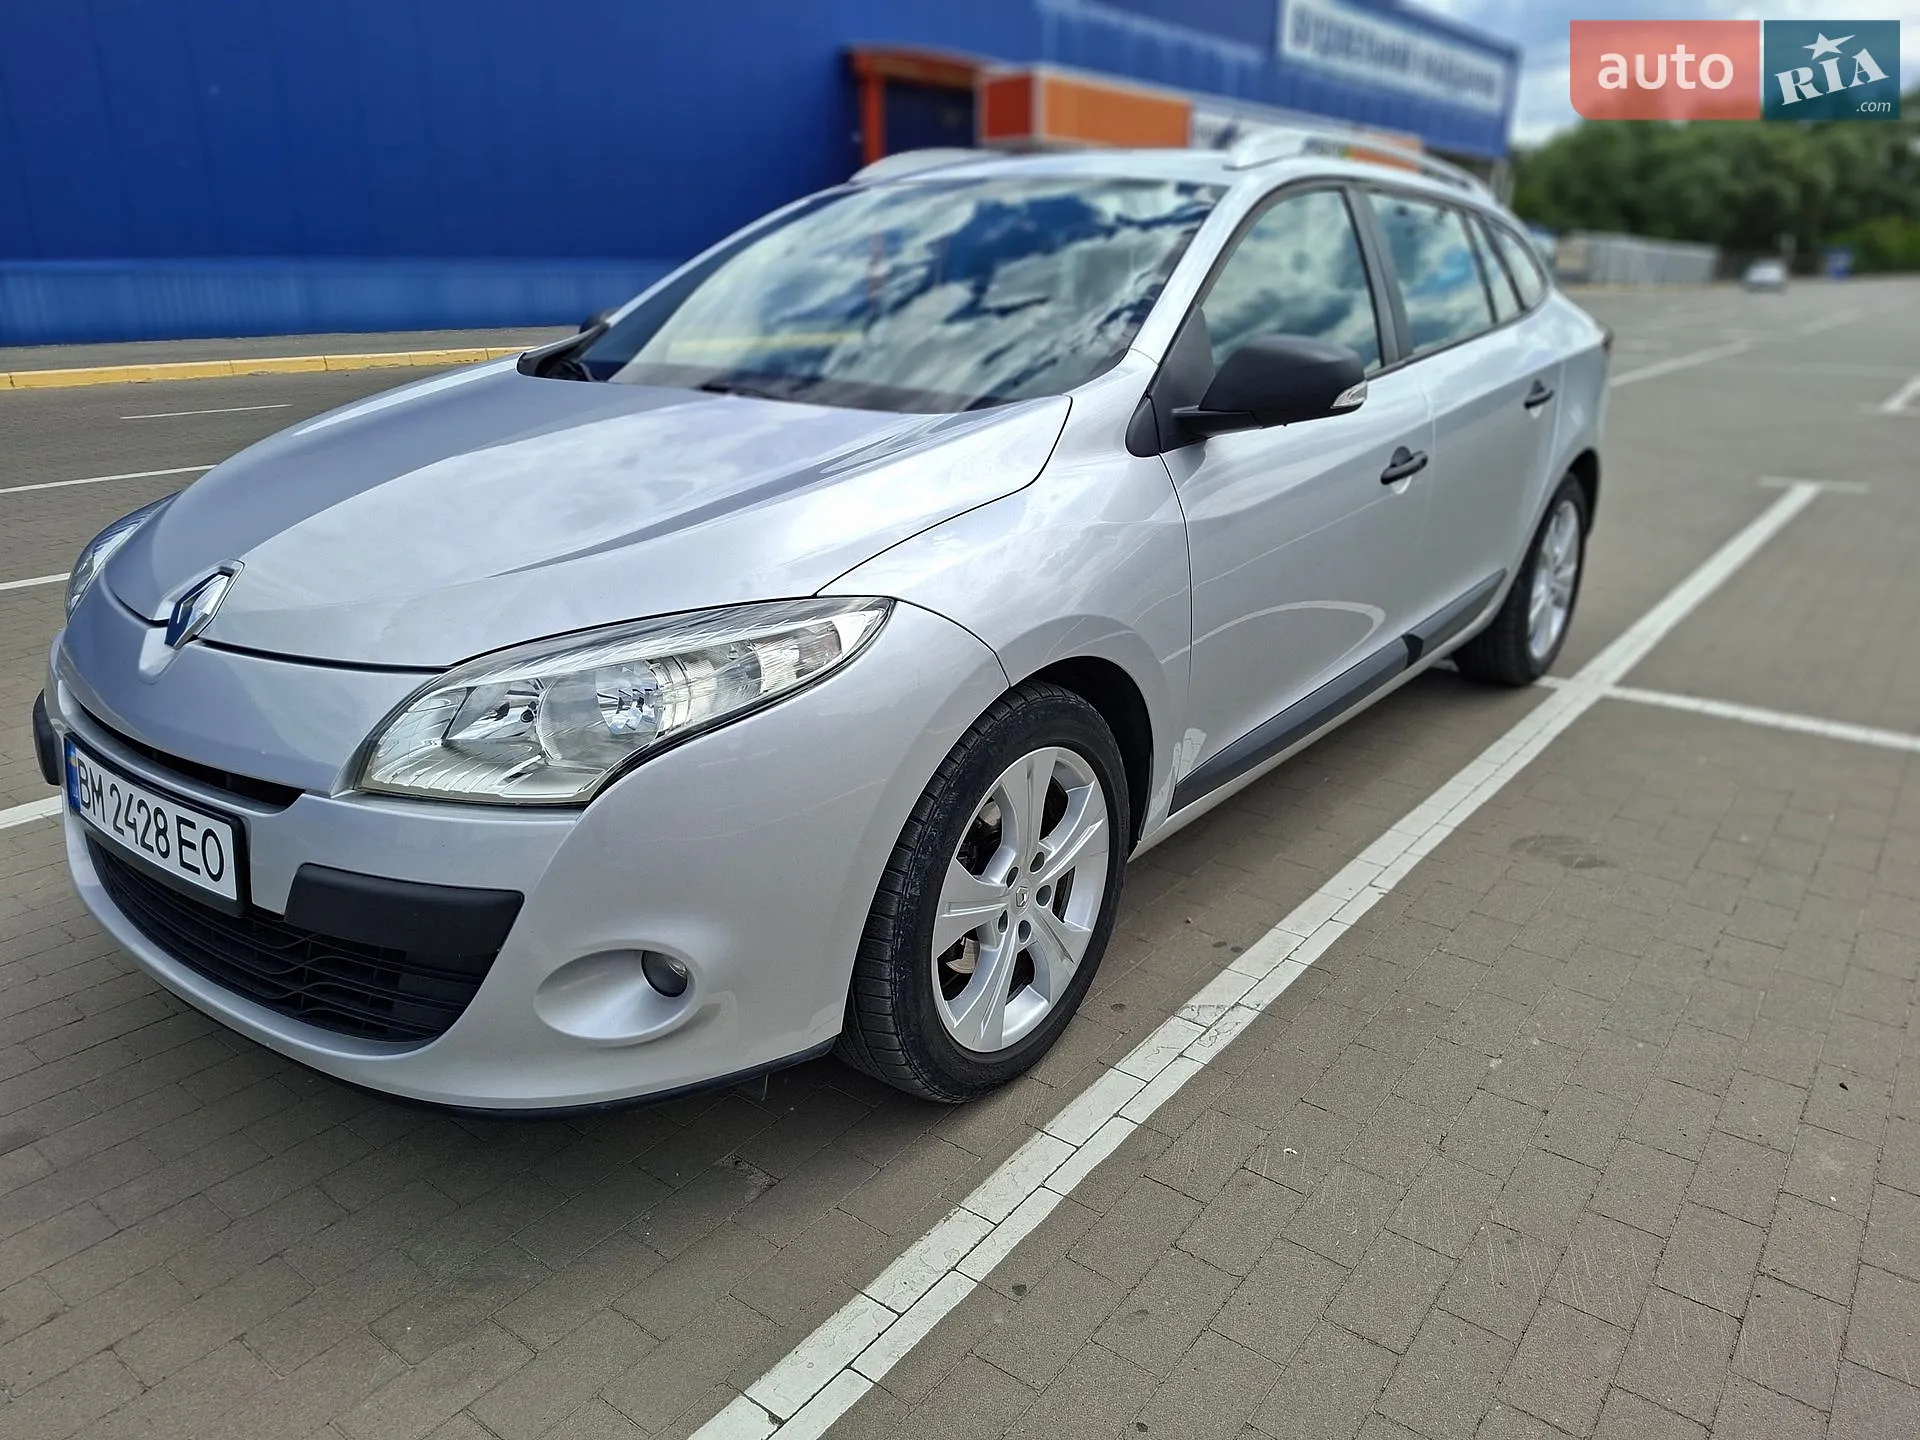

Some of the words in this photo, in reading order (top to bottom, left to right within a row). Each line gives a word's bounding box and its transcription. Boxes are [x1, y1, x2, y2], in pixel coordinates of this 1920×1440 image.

[77, 758, 107, 824] BM
[109, 783, 171, 860] 2428
[175, 814, 225, 883] EO
